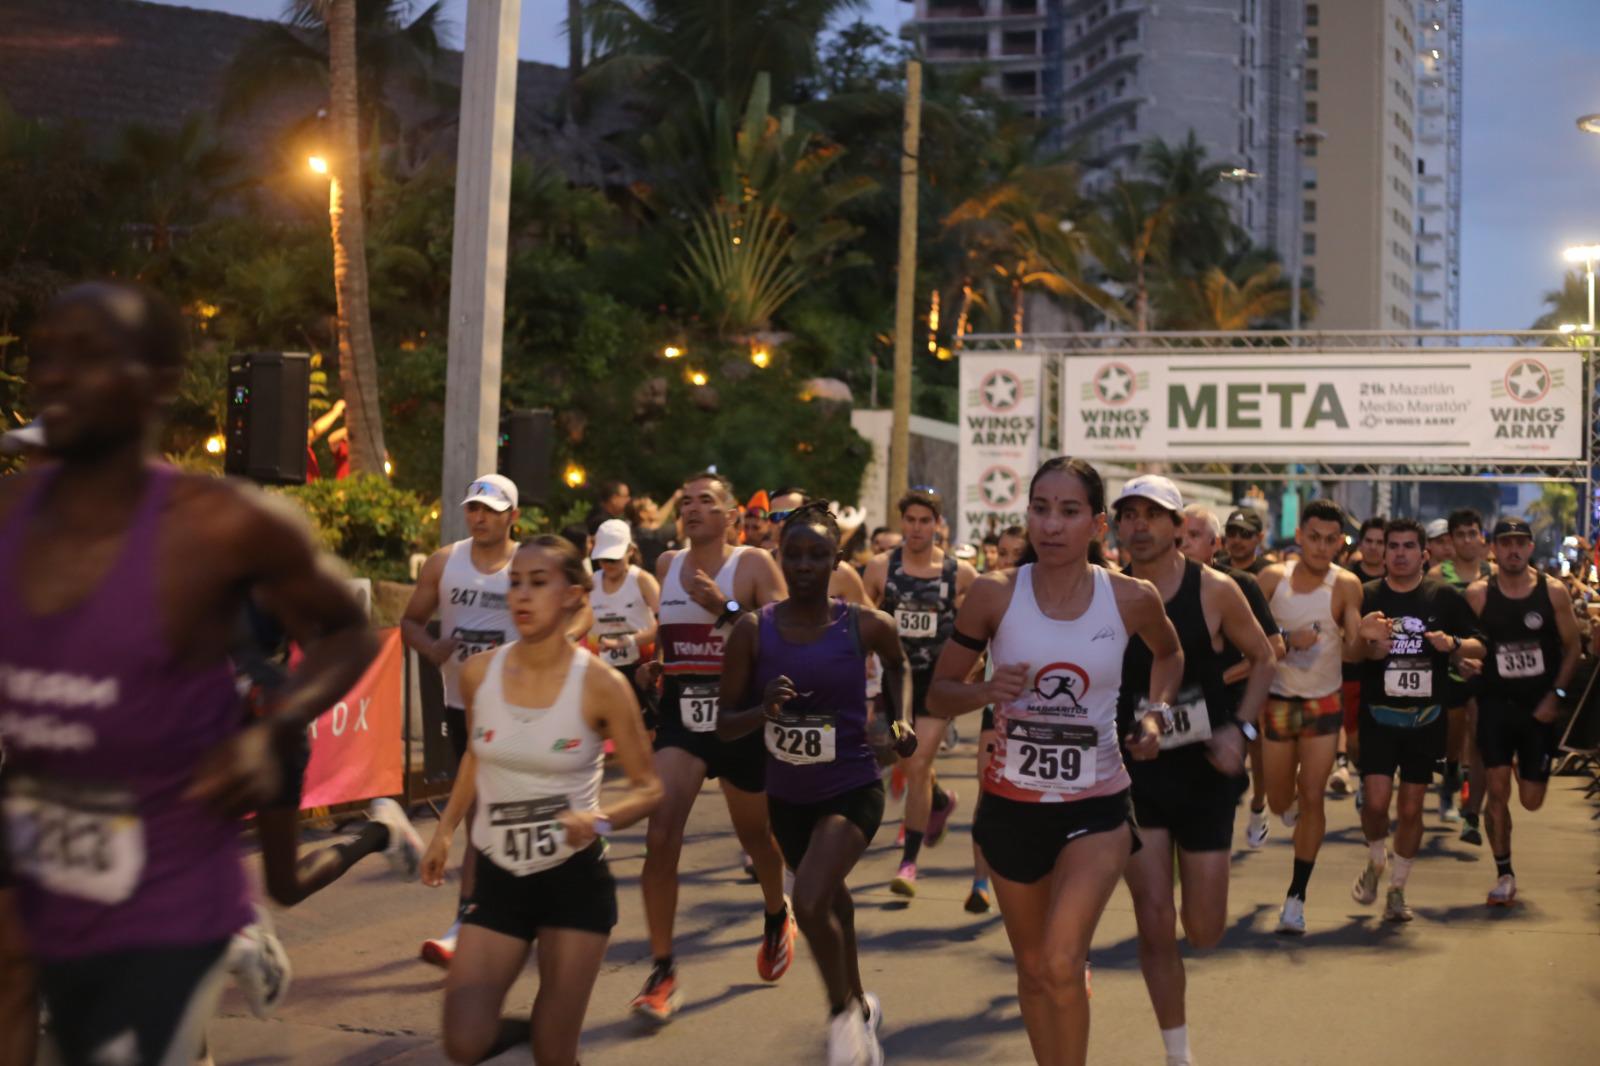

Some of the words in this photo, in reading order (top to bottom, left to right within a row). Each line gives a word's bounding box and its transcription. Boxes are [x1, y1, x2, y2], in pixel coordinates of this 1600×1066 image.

[1389, 382, 1455, 396] Mazatlán
[1167, 383, 1350, 429] META
[1359, 400, 1405, 413] Medio
[971, 432, 1030, 446] ARMY
[1085, 426, 1143, 440] ARMY
[1494, 424, 1559, 439] ARMY
[450, 588, 479, 607] 247
[900, 613, 931, 631] 530
[1398, 671, 1420, 690] 49
[690, 700, 719, 724] 37
[773, 722, 822, 758] 228
[1018, 744, 1082, 781] 259
[505, 823, 557, 862] 475
